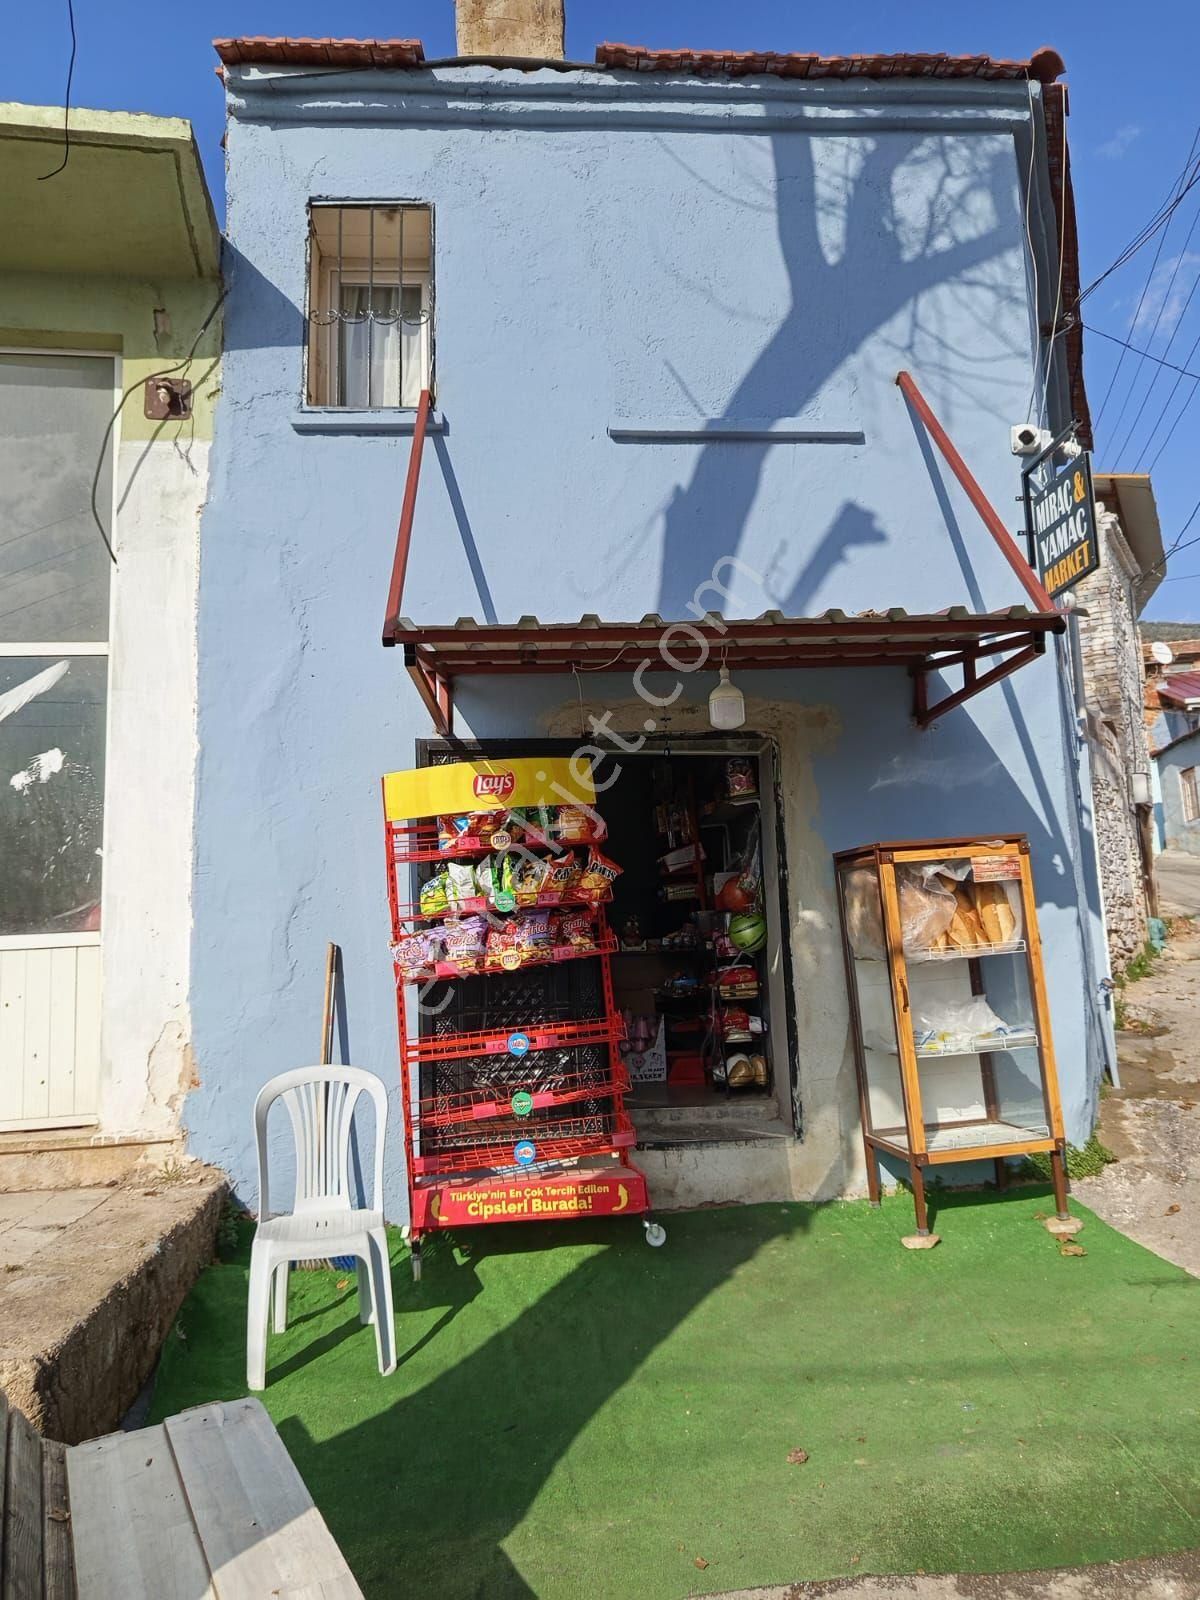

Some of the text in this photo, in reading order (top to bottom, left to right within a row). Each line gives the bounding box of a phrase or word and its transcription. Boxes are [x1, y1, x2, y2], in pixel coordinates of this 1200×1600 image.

[1036, 471, 1086, 534] MİRAÇ &
[1040, 507, 1087, 566] YAMAÇ
[1044, 540, 1090, 594] MARKET
[450, 1183, 609, 1203] Türkiye'nin En Çok Tercih Edilen
[467, 1195, 593, 1219] Cipsleri Burada!
